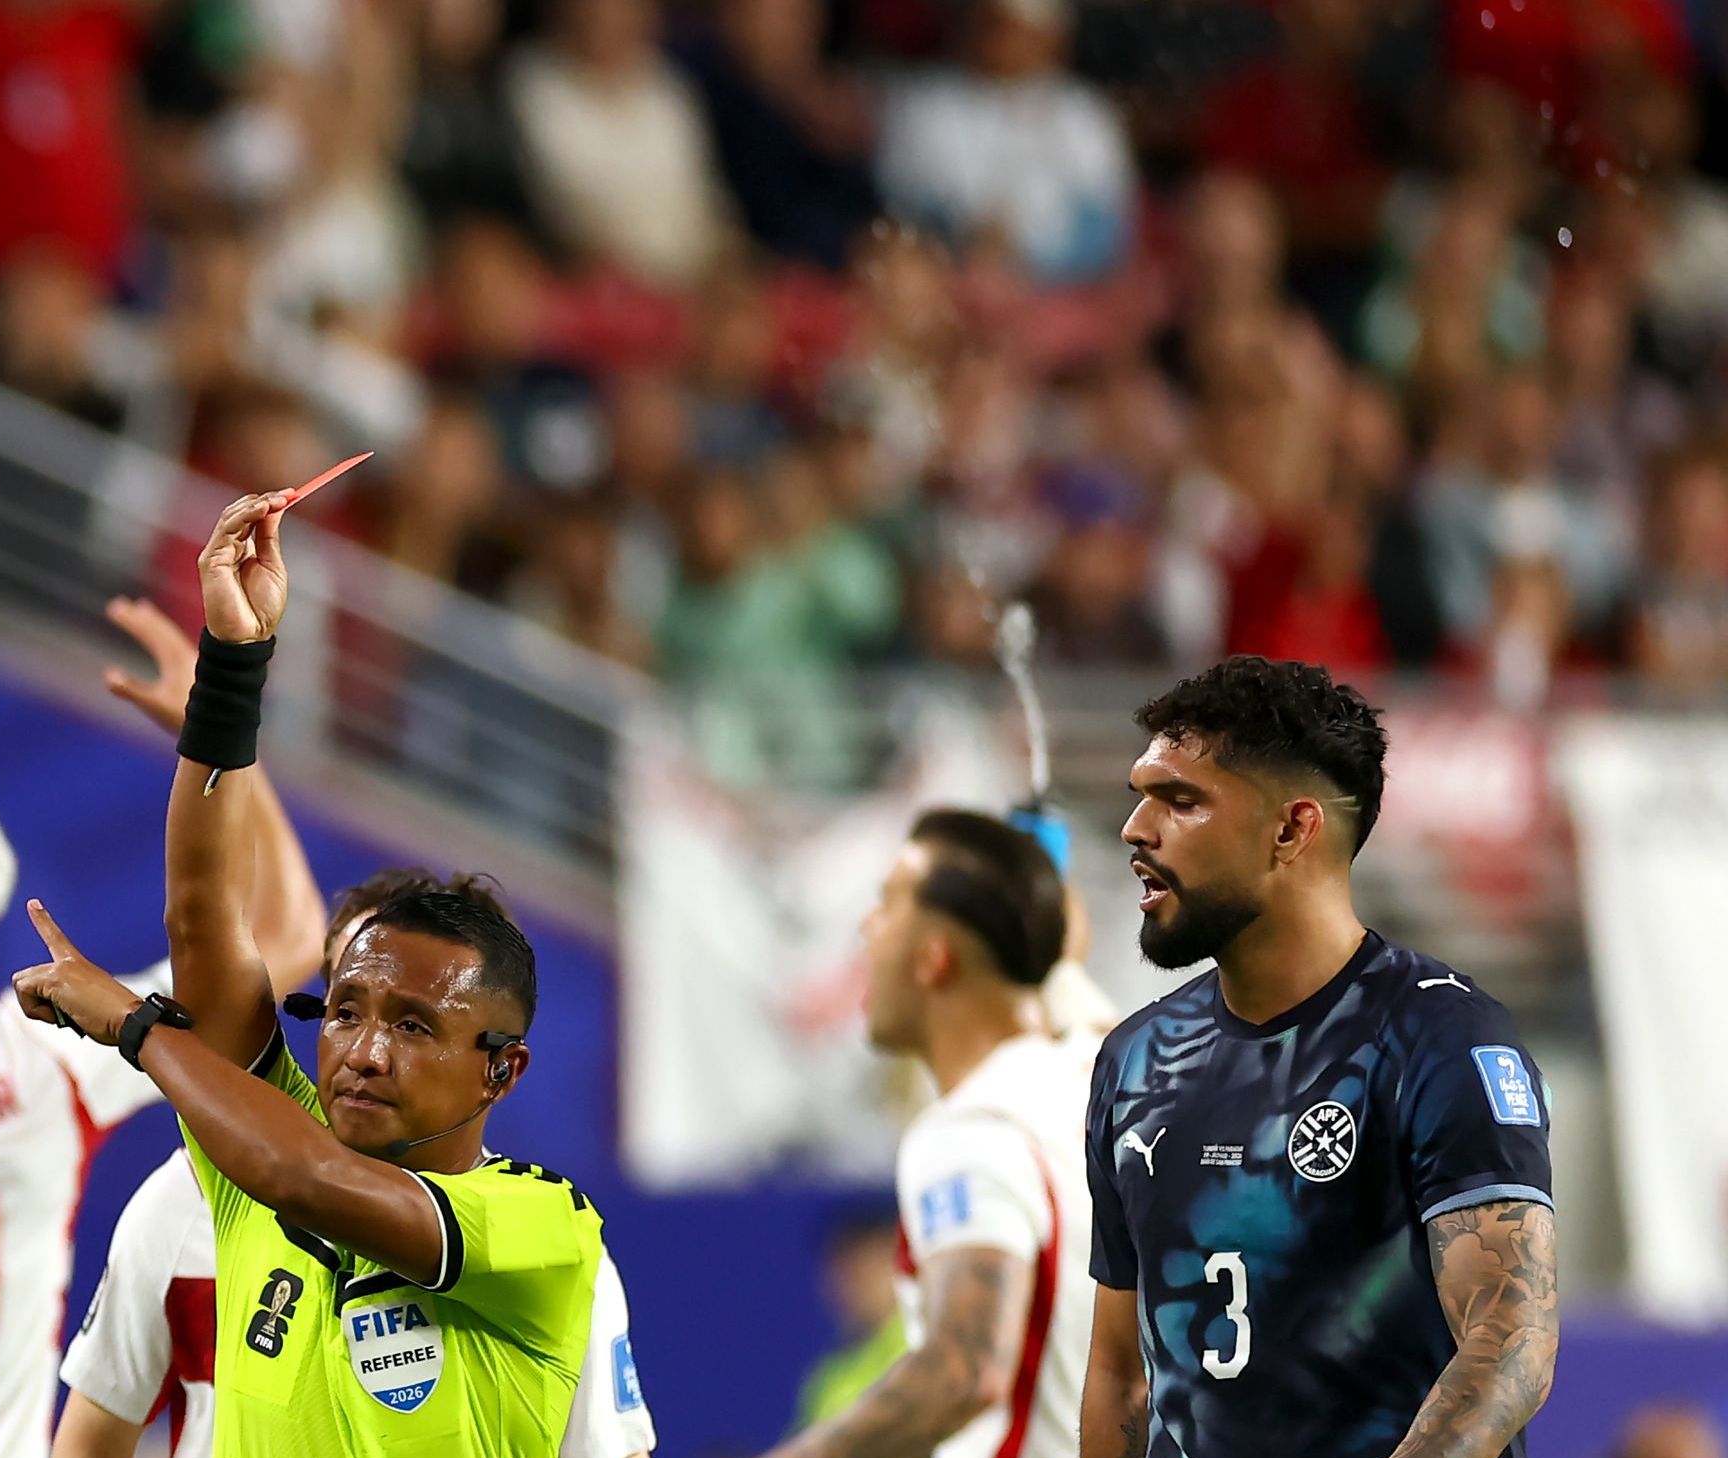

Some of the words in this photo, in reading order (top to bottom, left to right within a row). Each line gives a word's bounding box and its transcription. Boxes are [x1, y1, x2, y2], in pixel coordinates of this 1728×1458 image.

[1317, 1108, 1339, 1121] APF
[1303, 1165, 1336, 1177] PARAGUAY
[352, 1303, 430, 1343] FIFA
[1203, 1251, 1251, 1380] 3
[254, 1334, 274, 1351] FIFA
[360, 1346, 437, 1375] REFEREE
[389, 1386, 424, 1404] 2026
